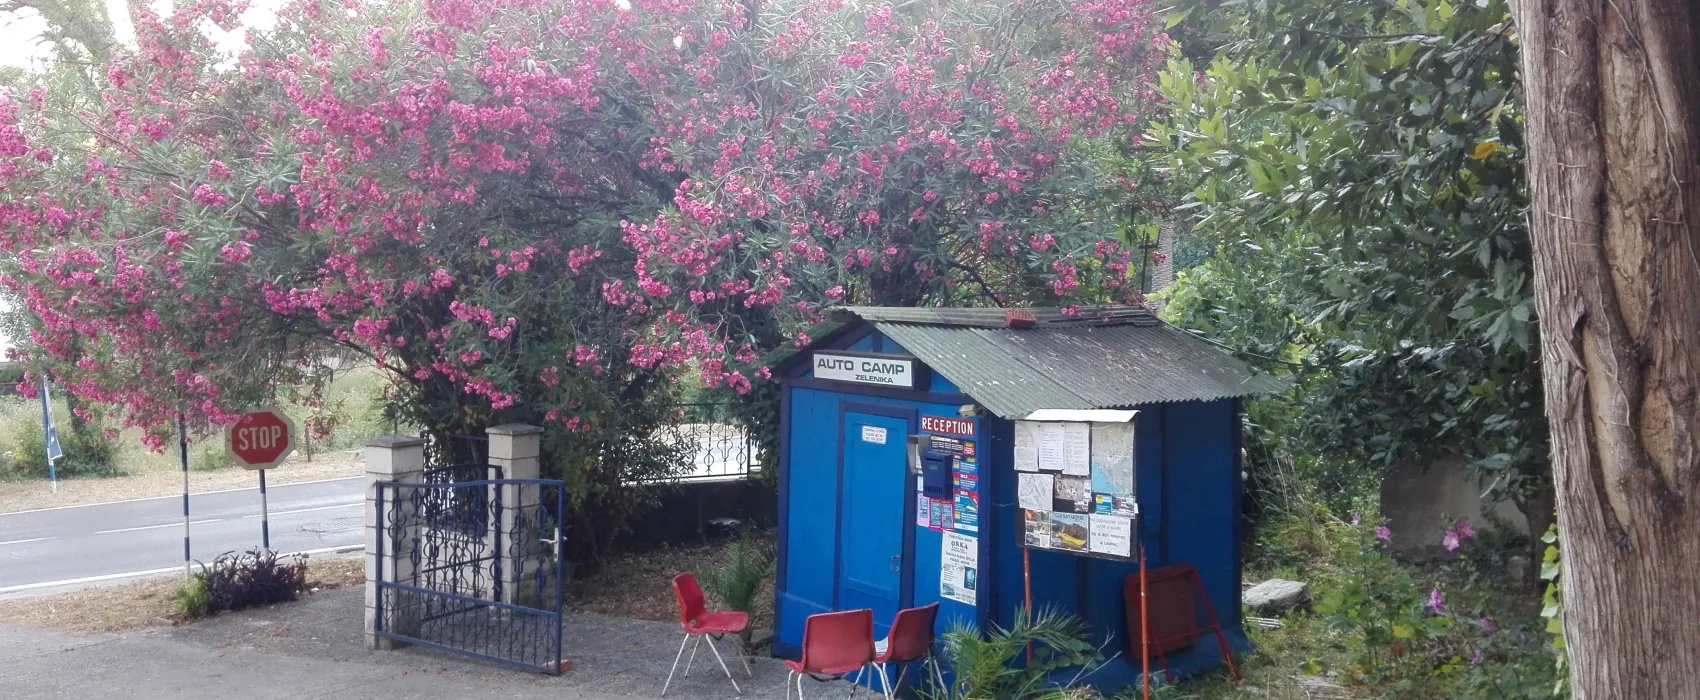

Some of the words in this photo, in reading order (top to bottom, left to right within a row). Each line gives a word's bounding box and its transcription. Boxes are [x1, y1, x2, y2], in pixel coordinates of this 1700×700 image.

[817, 358, 854, 371] AUTO
[861, 361, 905, 375] CAMP
[855, 374, 894, 383] ZELENIKA
[921, 417, 973, 435] RECEPTION
[238, 425, 282, 451] STOP
[950, 540, 968, 550] ORKA
